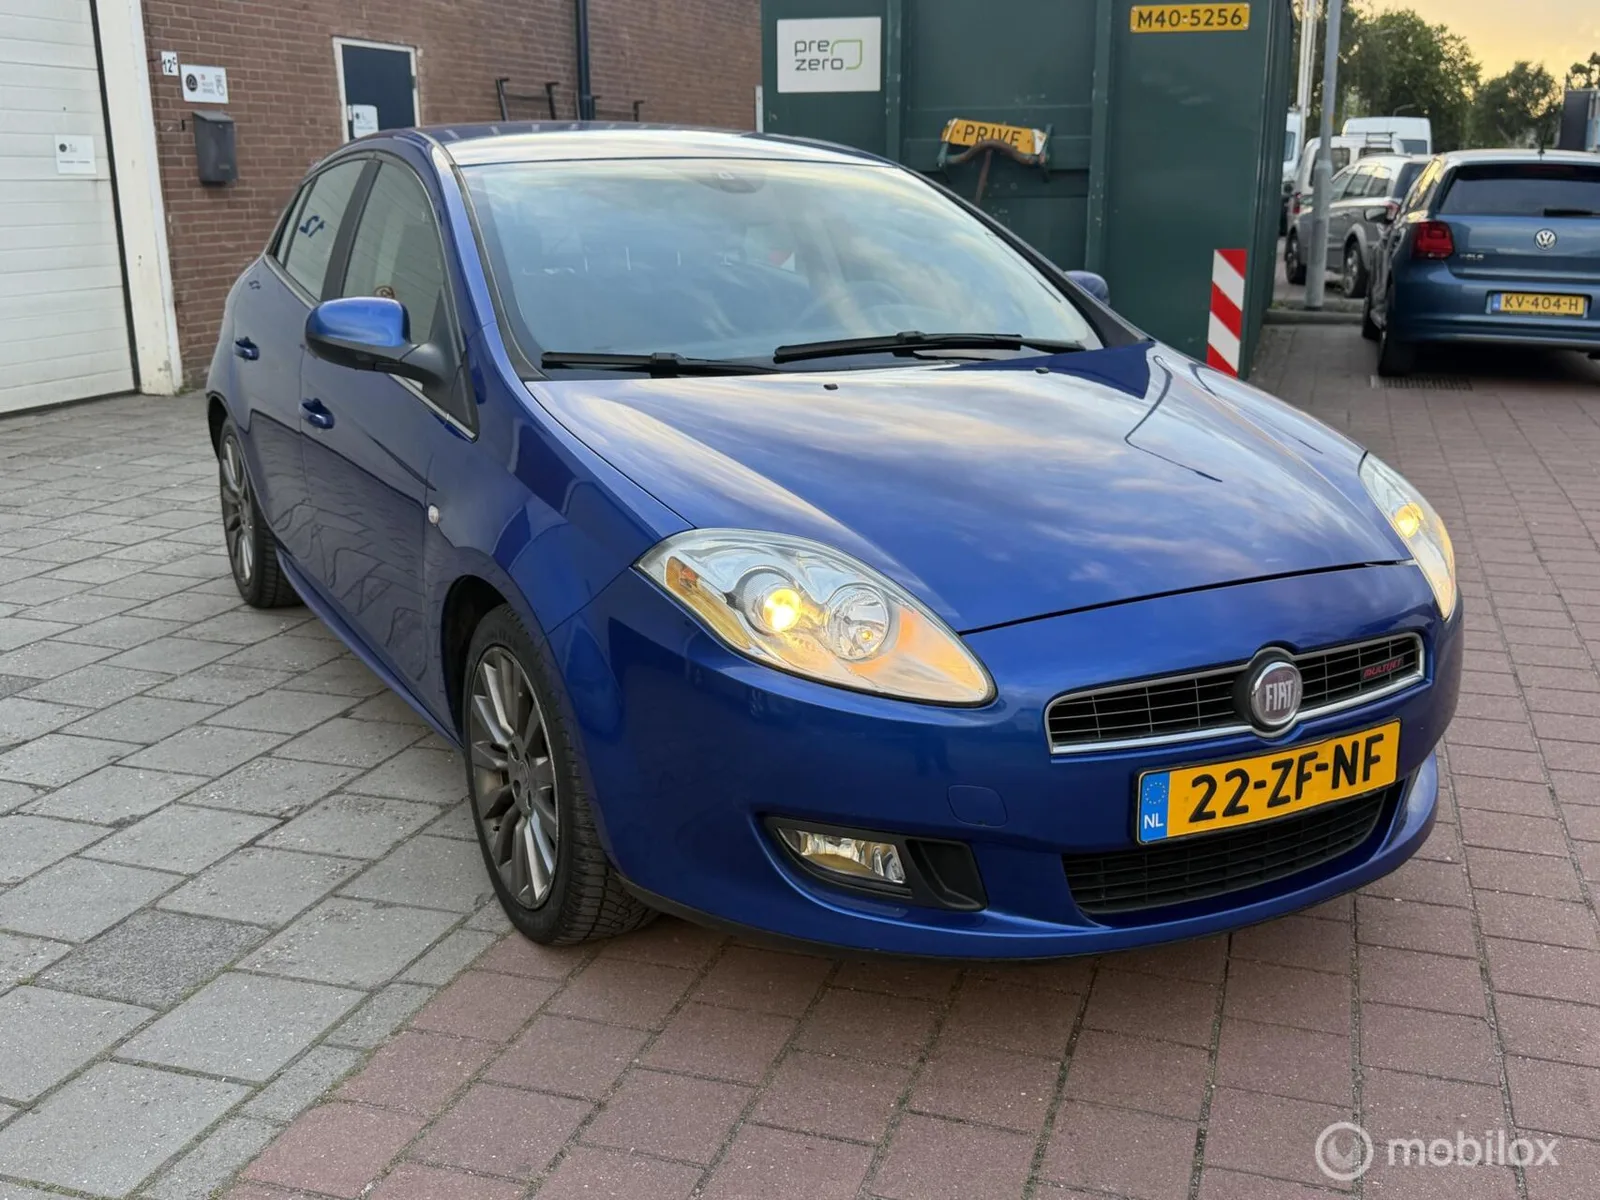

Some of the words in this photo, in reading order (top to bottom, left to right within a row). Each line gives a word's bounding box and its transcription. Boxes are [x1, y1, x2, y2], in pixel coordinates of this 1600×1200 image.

[1137, 8, 1242, 28] M40-5256
[794, 39, 830, 57] pre
[794, 57, 844, 71] zero
[962, 124, 1022, 146] PRIVE
[1504, 295, 1579, 311] KV-404-H
[1265, 680, 1293, 712] FIAT
[1188, 733, 1384, 823] 22-ZF-NF
[1144, 813, 1164, 829] NL
